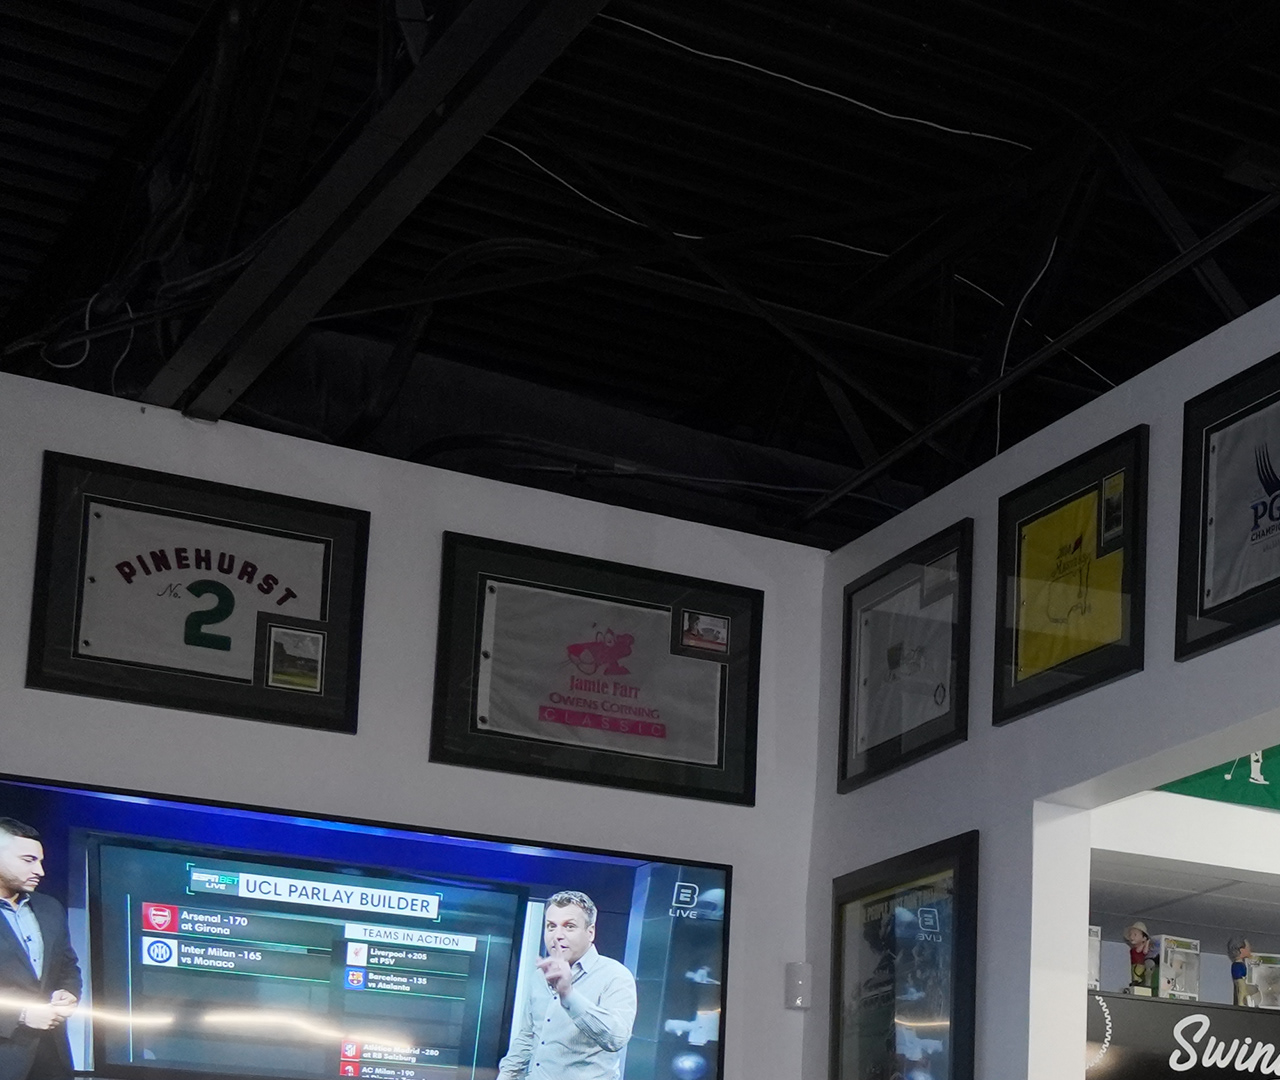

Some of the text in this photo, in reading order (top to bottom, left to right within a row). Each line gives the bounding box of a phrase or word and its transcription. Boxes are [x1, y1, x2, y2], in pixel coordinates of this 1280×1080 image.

[115, 548, 297, 606] PINEHURST
[157, 579, 235, 651] No. 2
[569, 675, 640, 699] Jamie Farr
[549, 692, 660, 718] OWENS CORNING
[544, 709, 661, 736] CLASSIC
[245, 881, 429, 913] UCL PARLAY BUILDER
[181, 911, 247, 926] Arsenal -170
[669, 908, 698, 919] LIVE
[181, 924, 230, 935] at Girona
[363, 928, 459, 946] TEAMS IN ACTION
[181, 945, 261, 961] Inter Milan -165
[371, 948, 406, 959] Liverpool
[194, 957, 235, 968] Monaco
